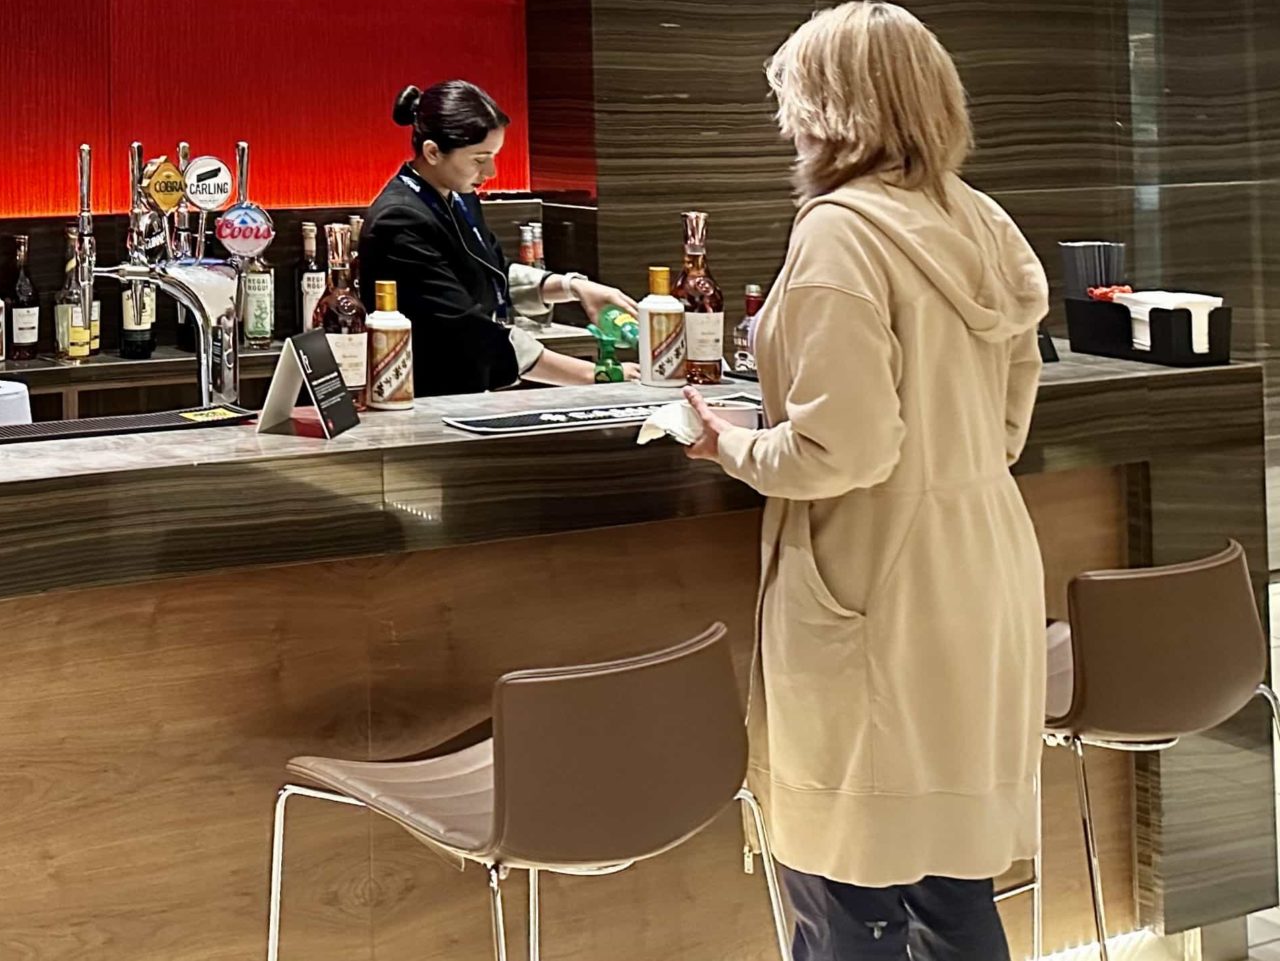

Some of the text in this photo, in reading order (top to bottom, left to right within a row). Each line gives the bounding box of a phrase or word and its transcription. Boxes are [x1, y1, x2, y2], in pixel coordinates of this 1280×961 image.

[154, 181, 184, 193] COBRA
[189, 182, 228, 195] CARLING
[216, 218, 276, 241] Coors
